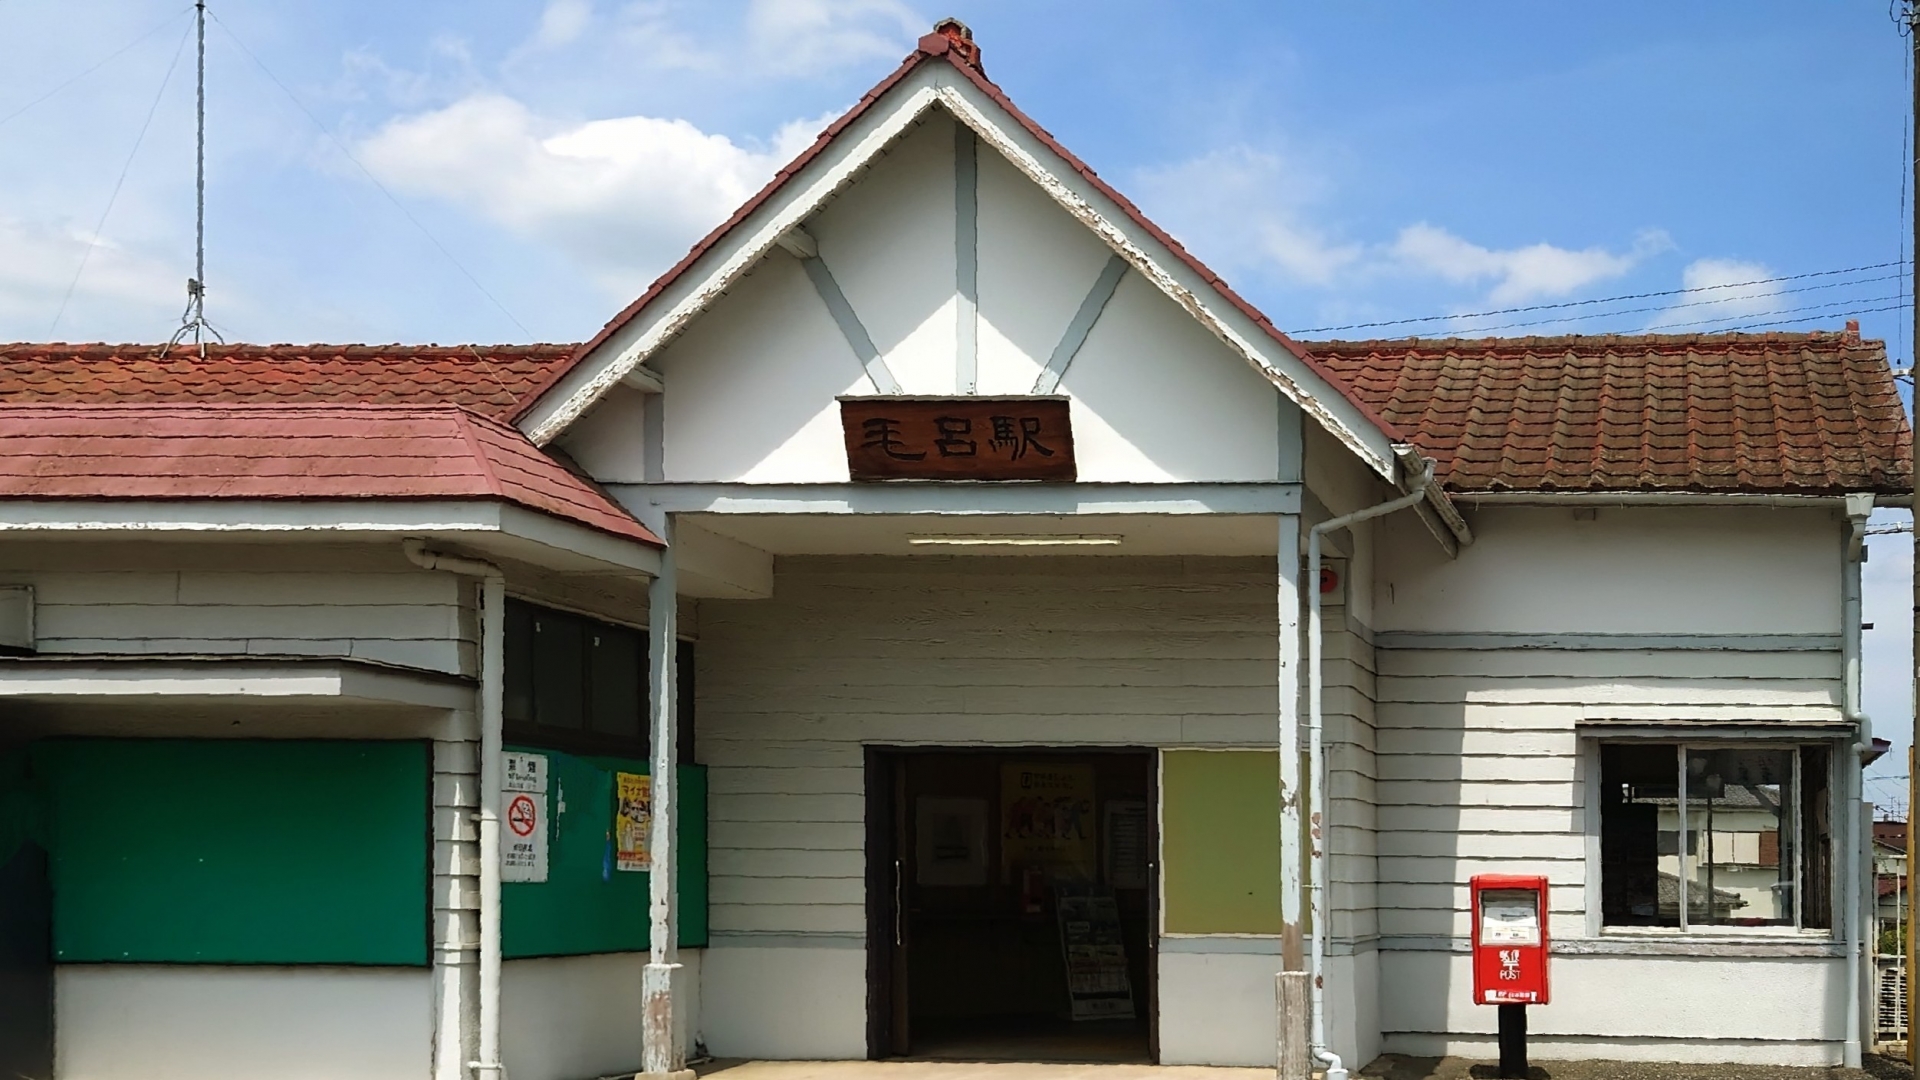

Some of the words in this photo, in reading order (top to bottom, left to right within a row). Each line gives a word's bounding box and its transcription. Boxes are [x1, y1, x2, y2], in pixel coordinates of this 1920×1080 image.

[861, 415, 1055, 461] 毛呂駅
[1499, 949, 1520, 962] 郵便
[1499, 970, 1520, 980] POST
